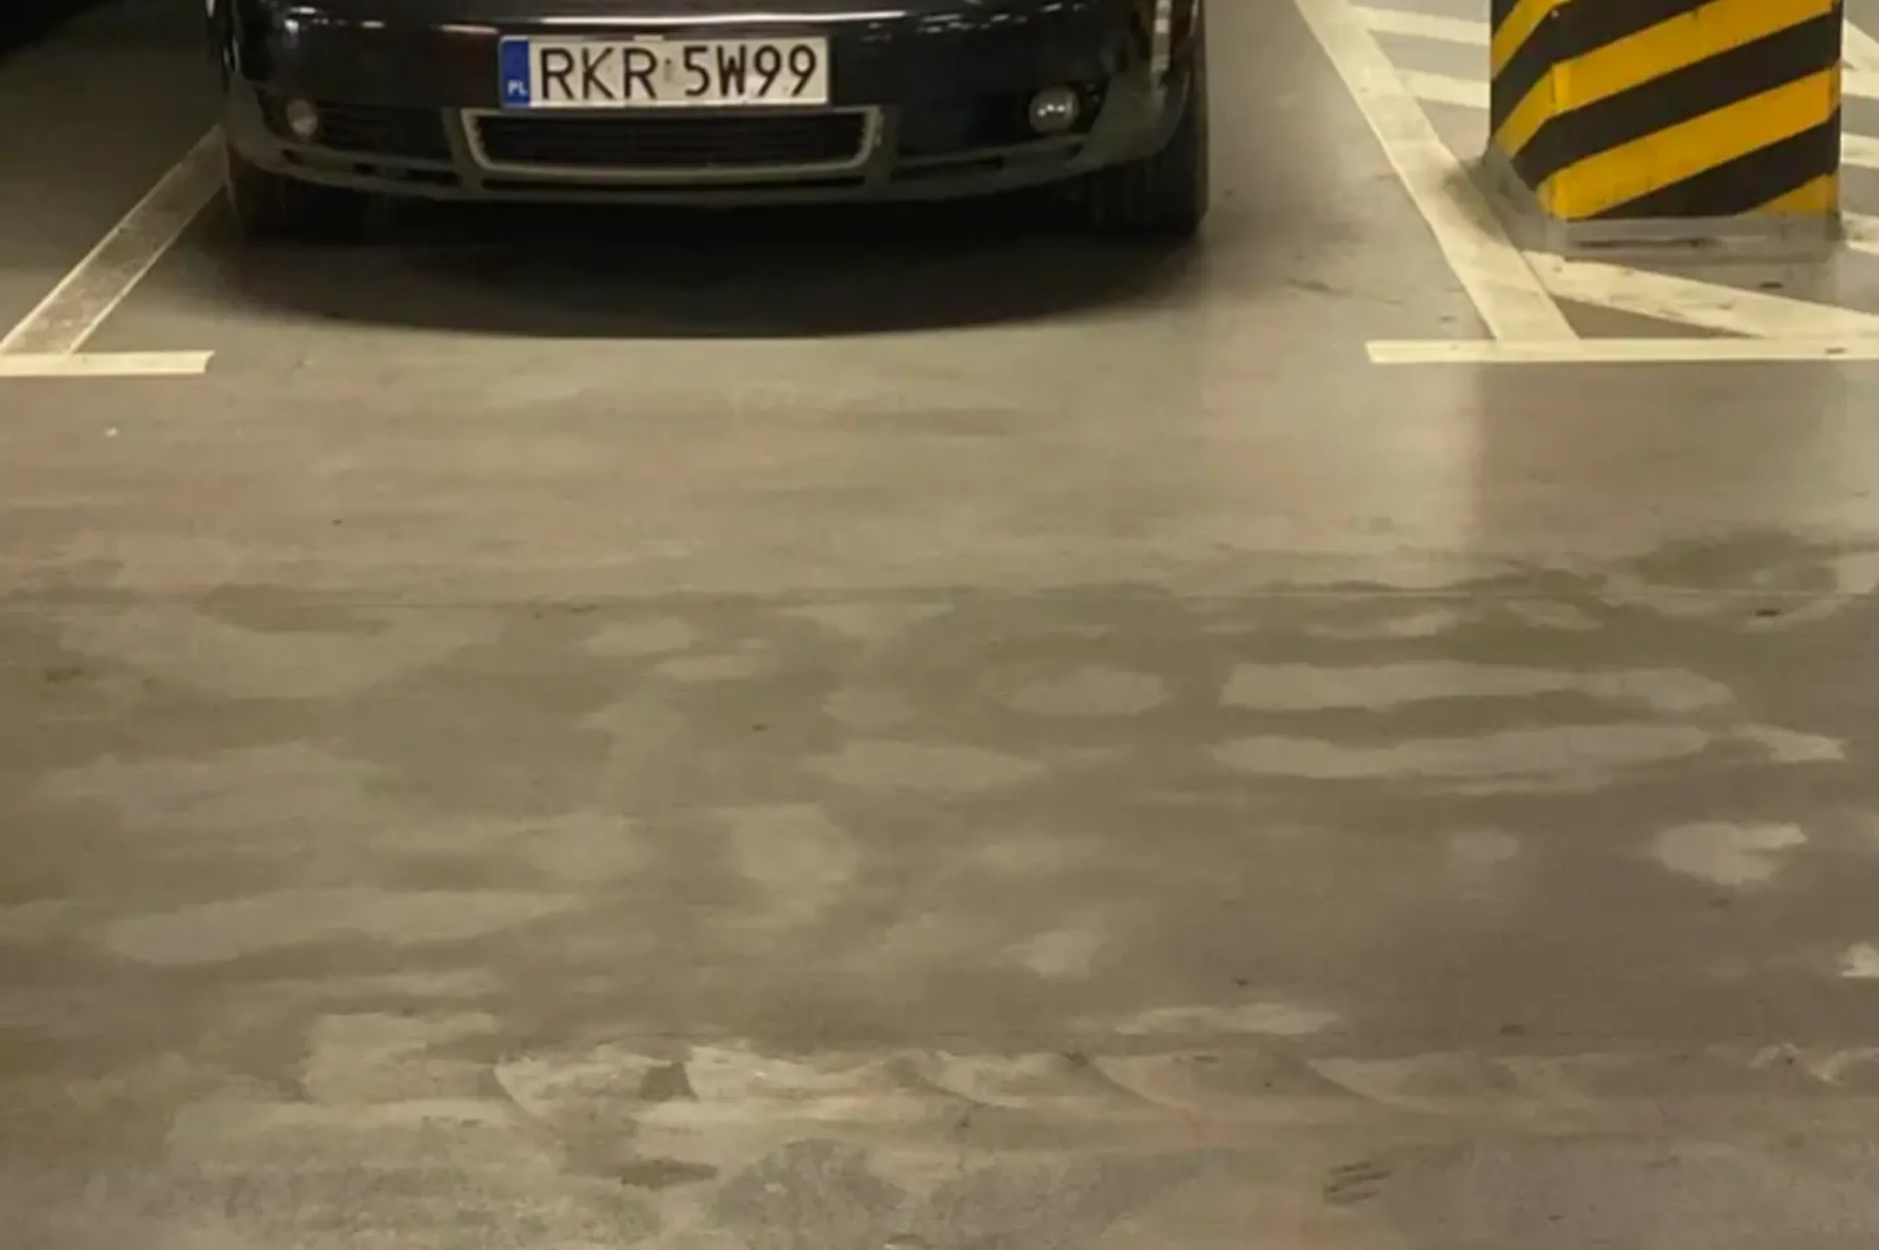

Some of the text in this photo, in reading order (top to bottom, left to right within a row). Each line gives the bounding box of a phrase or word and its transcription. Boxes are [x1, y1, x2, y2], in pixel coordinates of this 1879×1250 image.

[507, 81, 529, 96] PL
[541, 44, 817, 100] RKR 5W99
